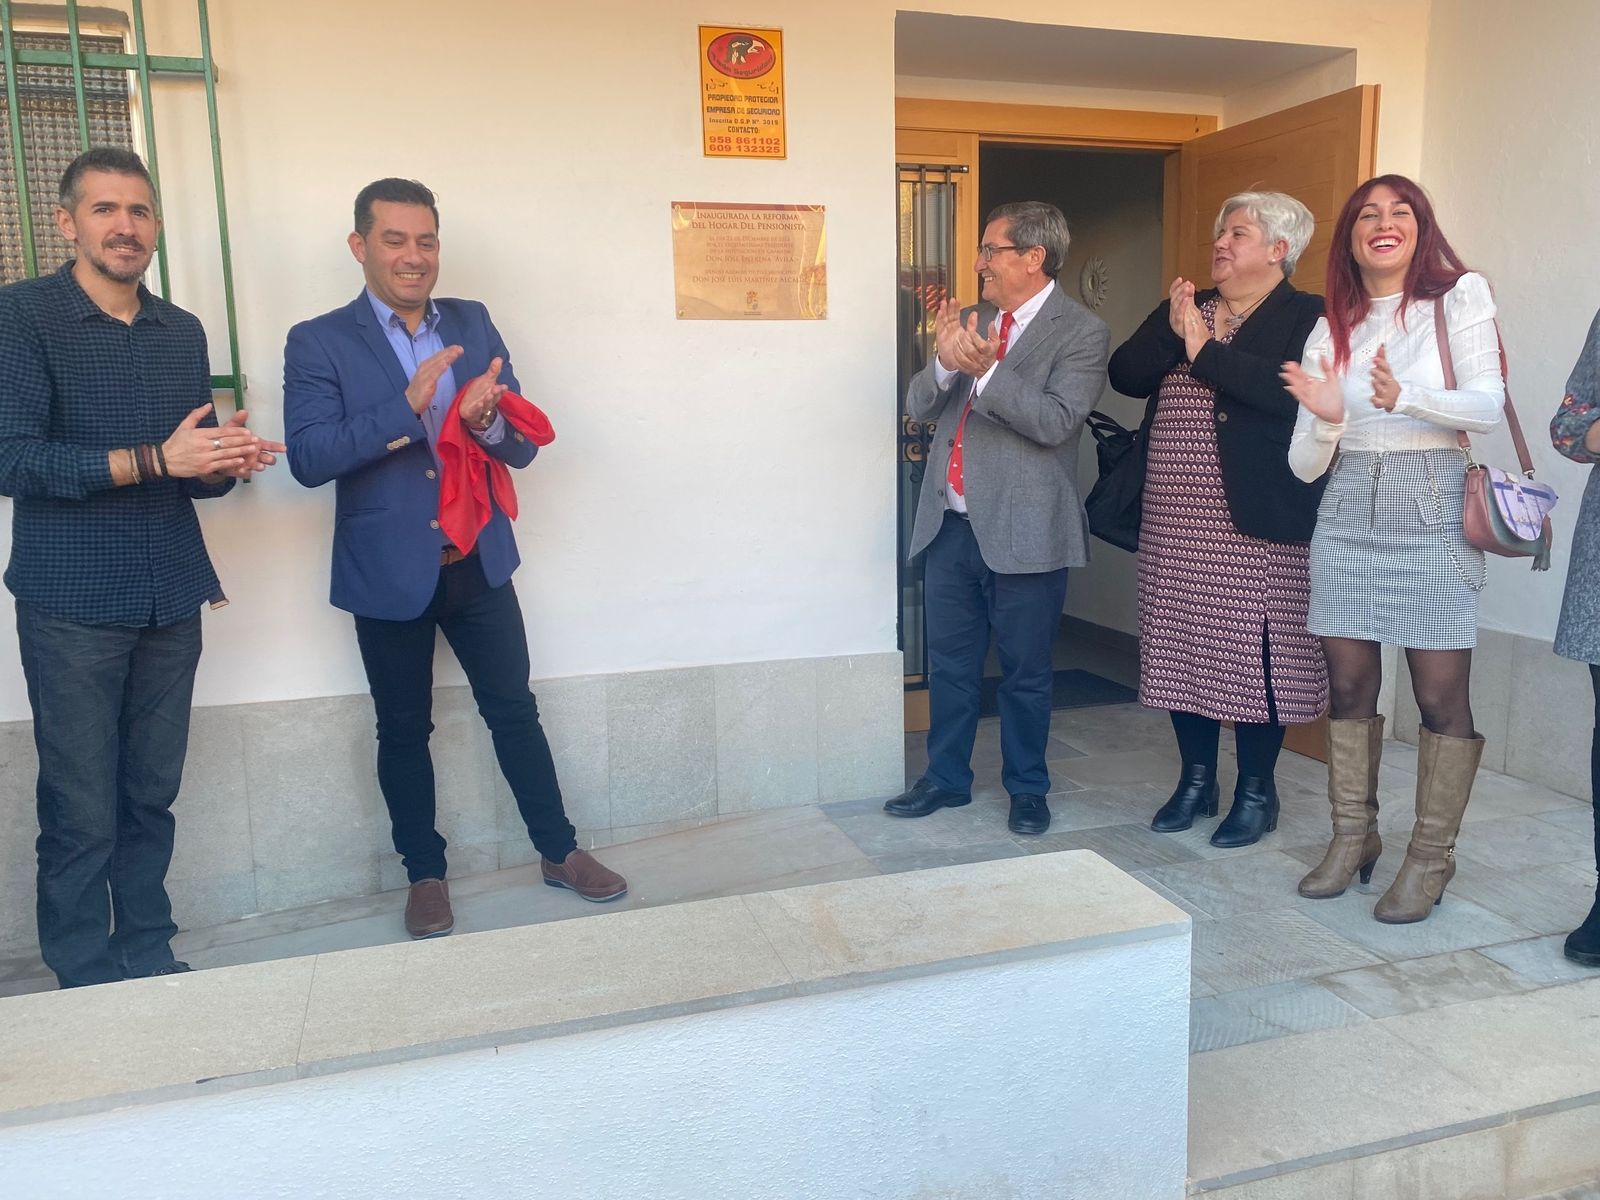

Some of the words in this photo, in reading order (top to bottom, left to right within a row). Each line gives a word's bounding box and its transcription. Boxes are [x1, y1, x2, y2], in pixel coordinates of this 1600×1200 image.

[706, 106, 735, 114] EMPRESA
[709, 136, 731, 144] 958
[736, 137, 780, 145] 861102
[709, 144, 731, 152] 609
[736, 145, 780, 153] 132325
[697, 211, 749, 219] INAUGURADA
[691, 221, 705, 229] DEL
[709, 221, 738, 229] HOGAR
[740, 222, 754, 230] DEL
[757, 222, 806, 230] PENSIONISTA
